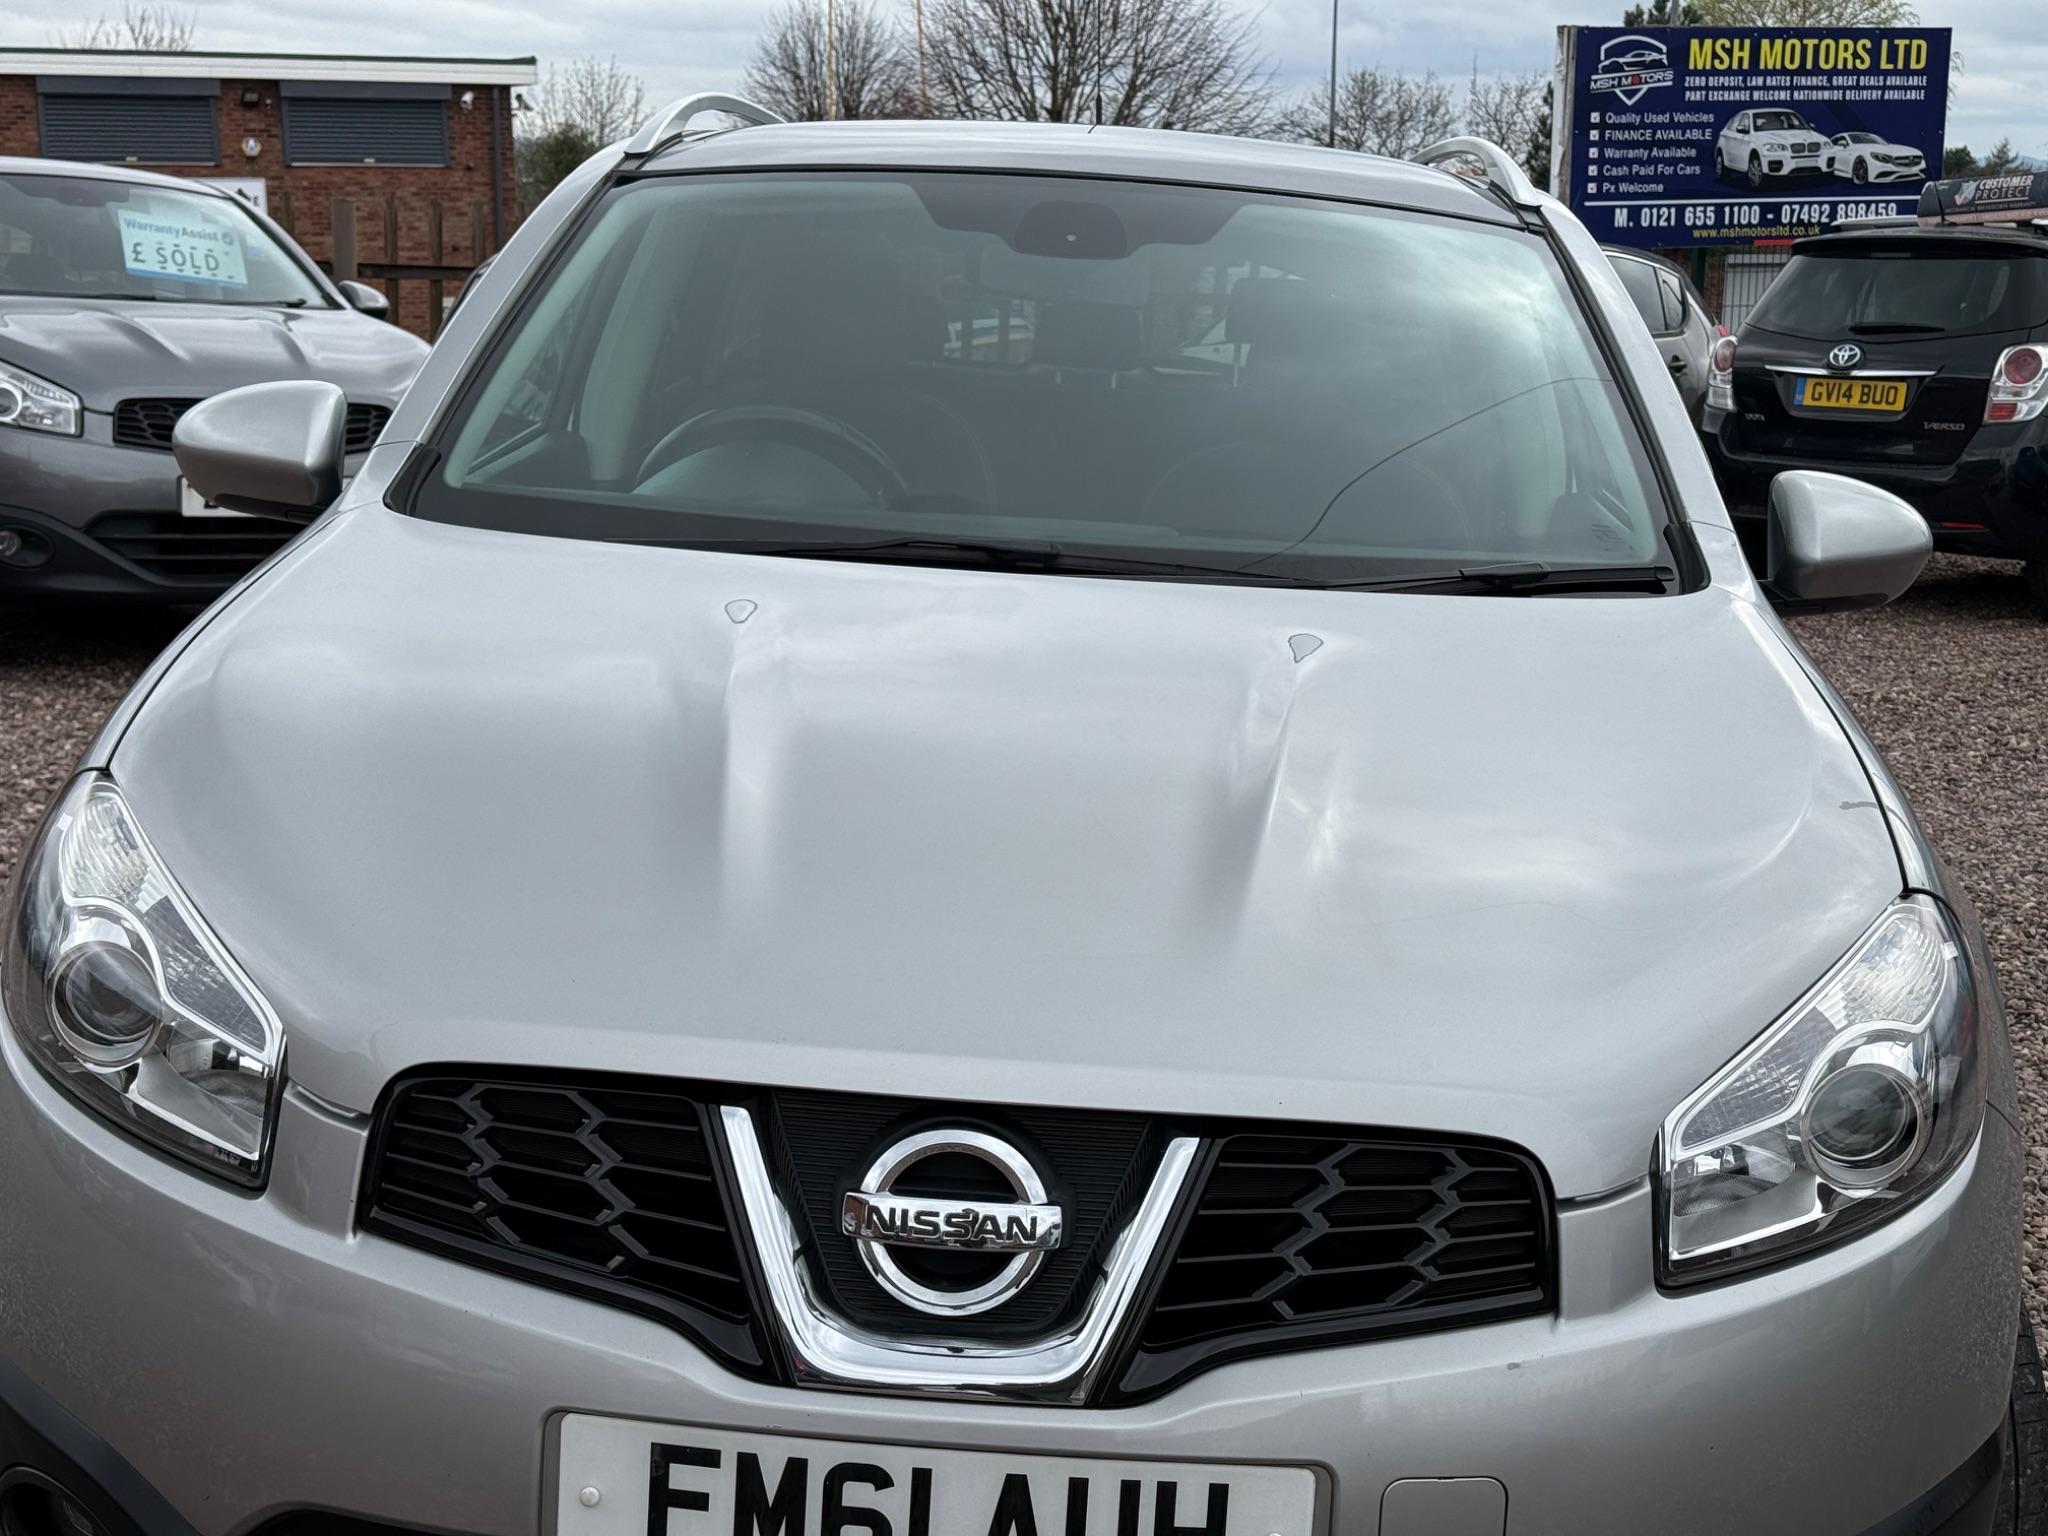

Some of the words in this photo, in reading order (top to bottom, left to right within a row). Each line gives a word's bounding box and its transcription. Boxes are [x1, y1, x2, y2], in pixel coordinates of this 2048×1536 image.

[1688, 38, 1751, 70] MSH
[1759, 38, 1872, 70] MOTORS
[1880, 38, 1928, 70] LTD
[1590, 77, 1618, 90] MSH
[1684, 76, 1706, 87] ZERO
[1766, 76, 1791, 86] RATES
[1832, 75, 1857, 86] GREAT
[1859, 75, 1884, 86] DEALS
[1885, 75, 1927, 86] AVAILABLE
[1685, 90, 1706, 101] PART
[1708, 90, 1750, 101] EXCHANGE
[1752, 90, 1791, 101] WELCOME
[1793, 90, 1843, 101] NATIONWIDE
[1845, 89, 1882, 100] DELIVERY
[1883, 89, 1925, 100] AVAILABLE
[1605, 112, 1641, 125] Quality
[1644, 111, 1670, 123] Used
[1672, 111, 1715, 123] Vehicles
[1605, 129, 1653, 141] FINANCE
[1655, 128, 1713, 140] AVAILABLE
[1603, 147, 1649, 160] Warranty
[1650, 146, 1697, 158] Available
[1603, 165, 1629, 176] Cash
[1632, 164, 1655, 176] Paid
[1657, 164, 1674, 175] For
[1677, 163, 1701, 175] Cars
[1602, 182, 1615, 193] Px
[1618, 182, 1664, 193] Welcome
[1979, 175, 2034, 190] CUSTOMER
[1975, 187, 2032, 200] PROTECT
[1614, 207, 1633, 227] M.
[1640, 207, 1676, 227] 0121
[1684, 206, 1715, 226] 655
[1724, 205, 1760, 225] 1100
[1781, 204, 1830, 224] 07492
[1837, 202, 1897, 221] 898459
[1693, 225, 1820, 238] www.mshmotorsltd.co.uk
[132, 242, 146, 264] £
[156, 246, 220, 272] SOLD
[1811, 382, 1853, 403] GV14
[1858, 383, 1899, 405] BUO
[865, 1205, 1038, 1242] NISSAN
[647, 1441, 933, 1536] FM61
